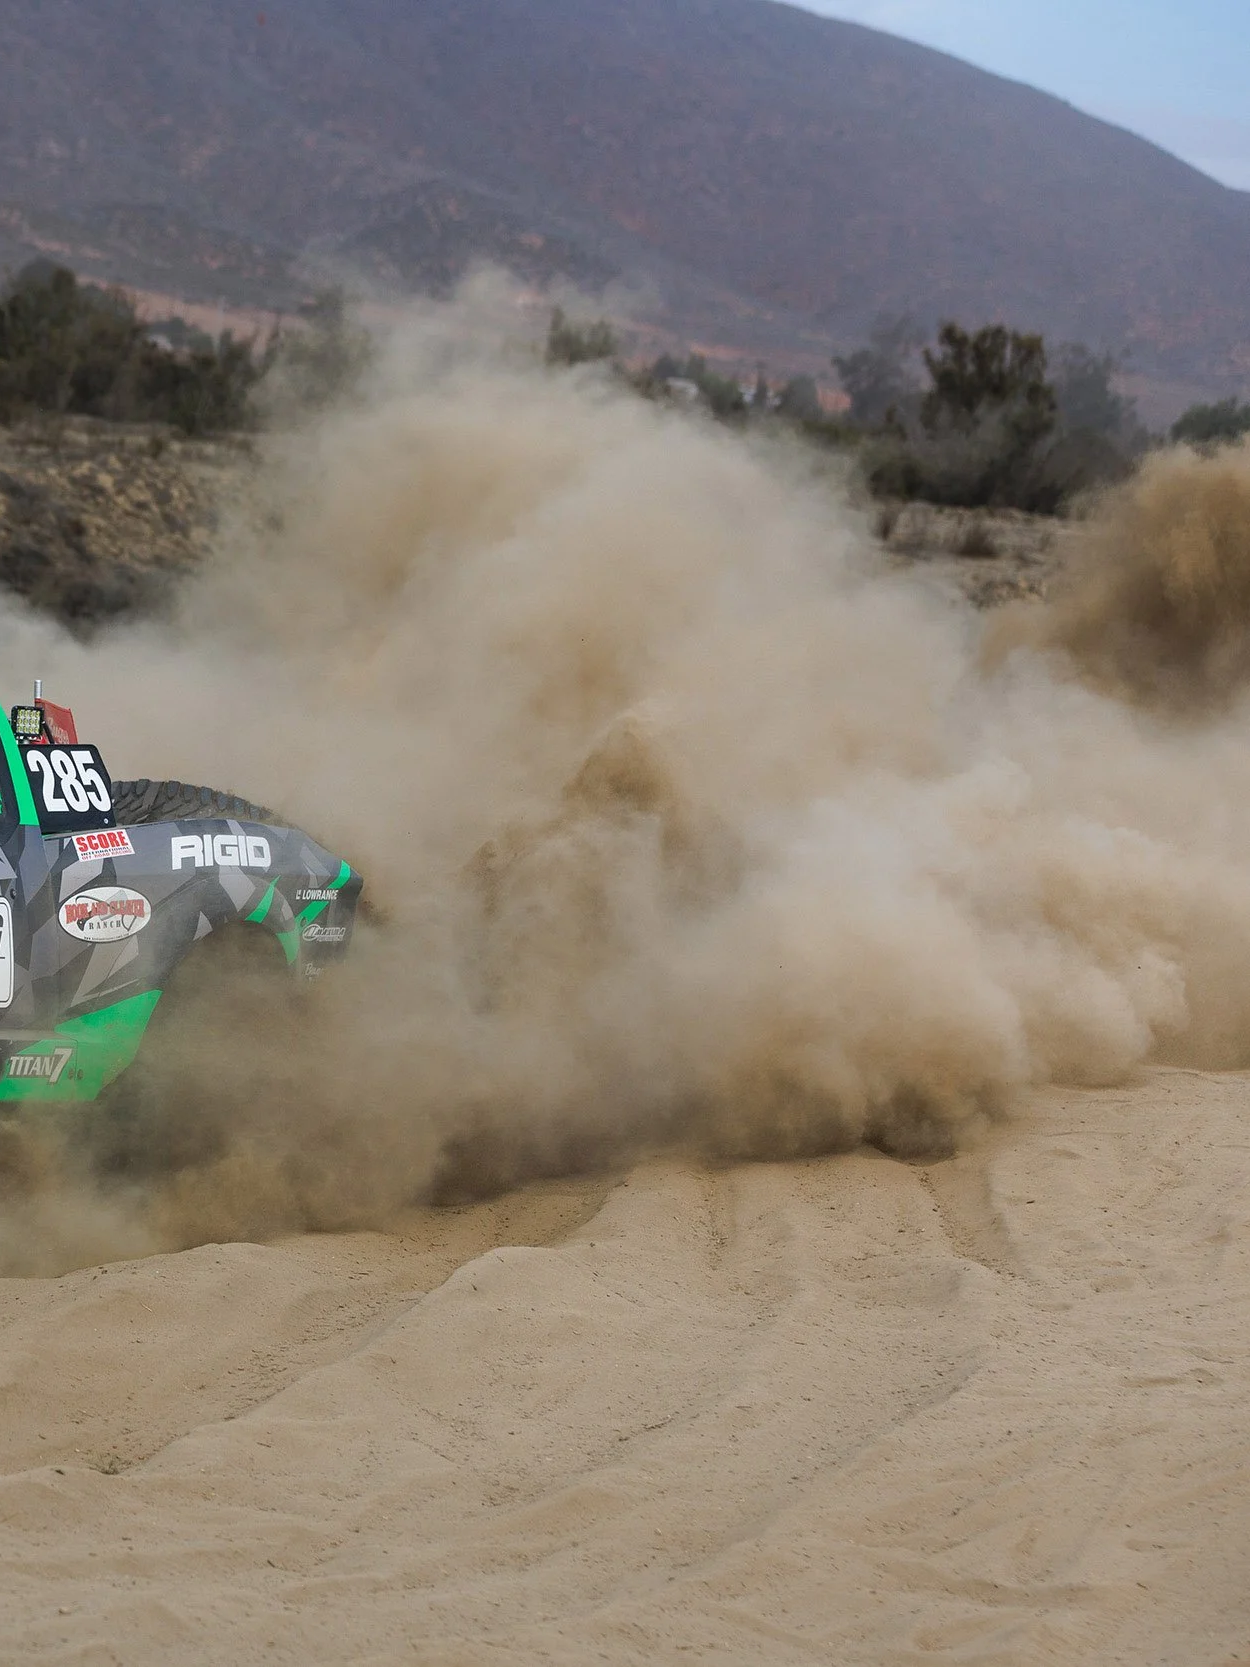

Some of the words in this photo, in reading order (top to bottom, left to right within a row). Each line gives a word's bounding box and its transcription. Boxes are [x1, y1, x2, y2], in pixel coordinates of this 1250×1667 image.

[26, 750, 112, 813] 285
[75, 831, 128, 852] SCORE
[171, 834, 272, 870] RIGID
[302, 889, 339, 900] LOWRANCE
[89, 920, 121, 930] RANCH
